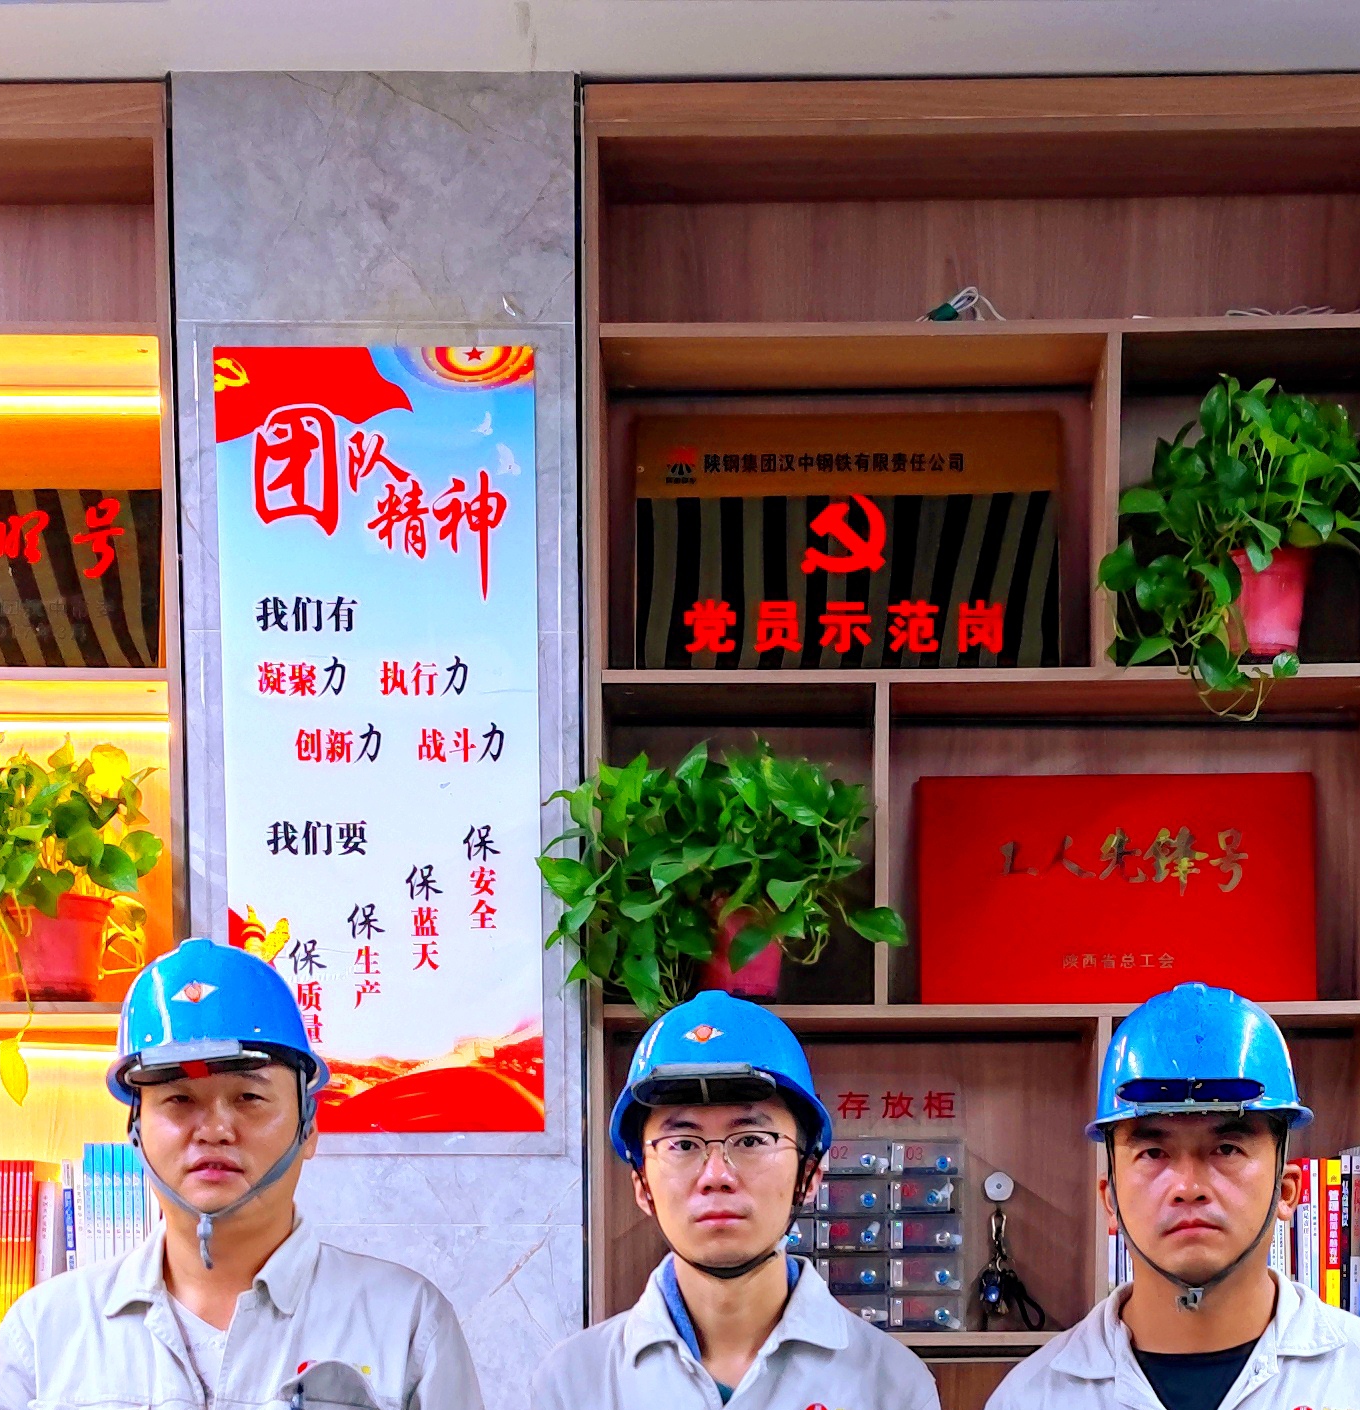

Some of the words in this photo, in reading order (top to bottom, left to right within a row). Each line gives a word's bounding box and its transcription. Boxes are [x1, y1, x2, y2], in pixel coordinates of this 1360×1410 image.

[704, 452, 965, 474] 陕钢集团汉中钢铁有限责任公司
[254, 405, 508, 601] 团队精神
[256, 597, 358, 632] 我们有
[683, 599, 1004, 654] 党员示范岗
[257, 656, 347, 697] 凝聚力
[380, 655, 469, 697] 执行力
[295, 723, 383, 765] 创新力
[418, 722, 505, 764] 战斗力
[266, 820, 369, 856] 我们要
[462, 825, 502, 930] 保安全
[999, 826, 1249, 897] 工人先锋号
[405, 864, 444, 972] 保蓝天
[347, 903, 386, 1010] 保生产
[1062, 952, 1176, 969] 陕西省总工会
[288, 938, 328, 1044] 保质量
[815, 1090, 956, 1120] 存放柜
[830, 1145, 849, 1160] 02
[905, 1146, 924, 1161] 03
